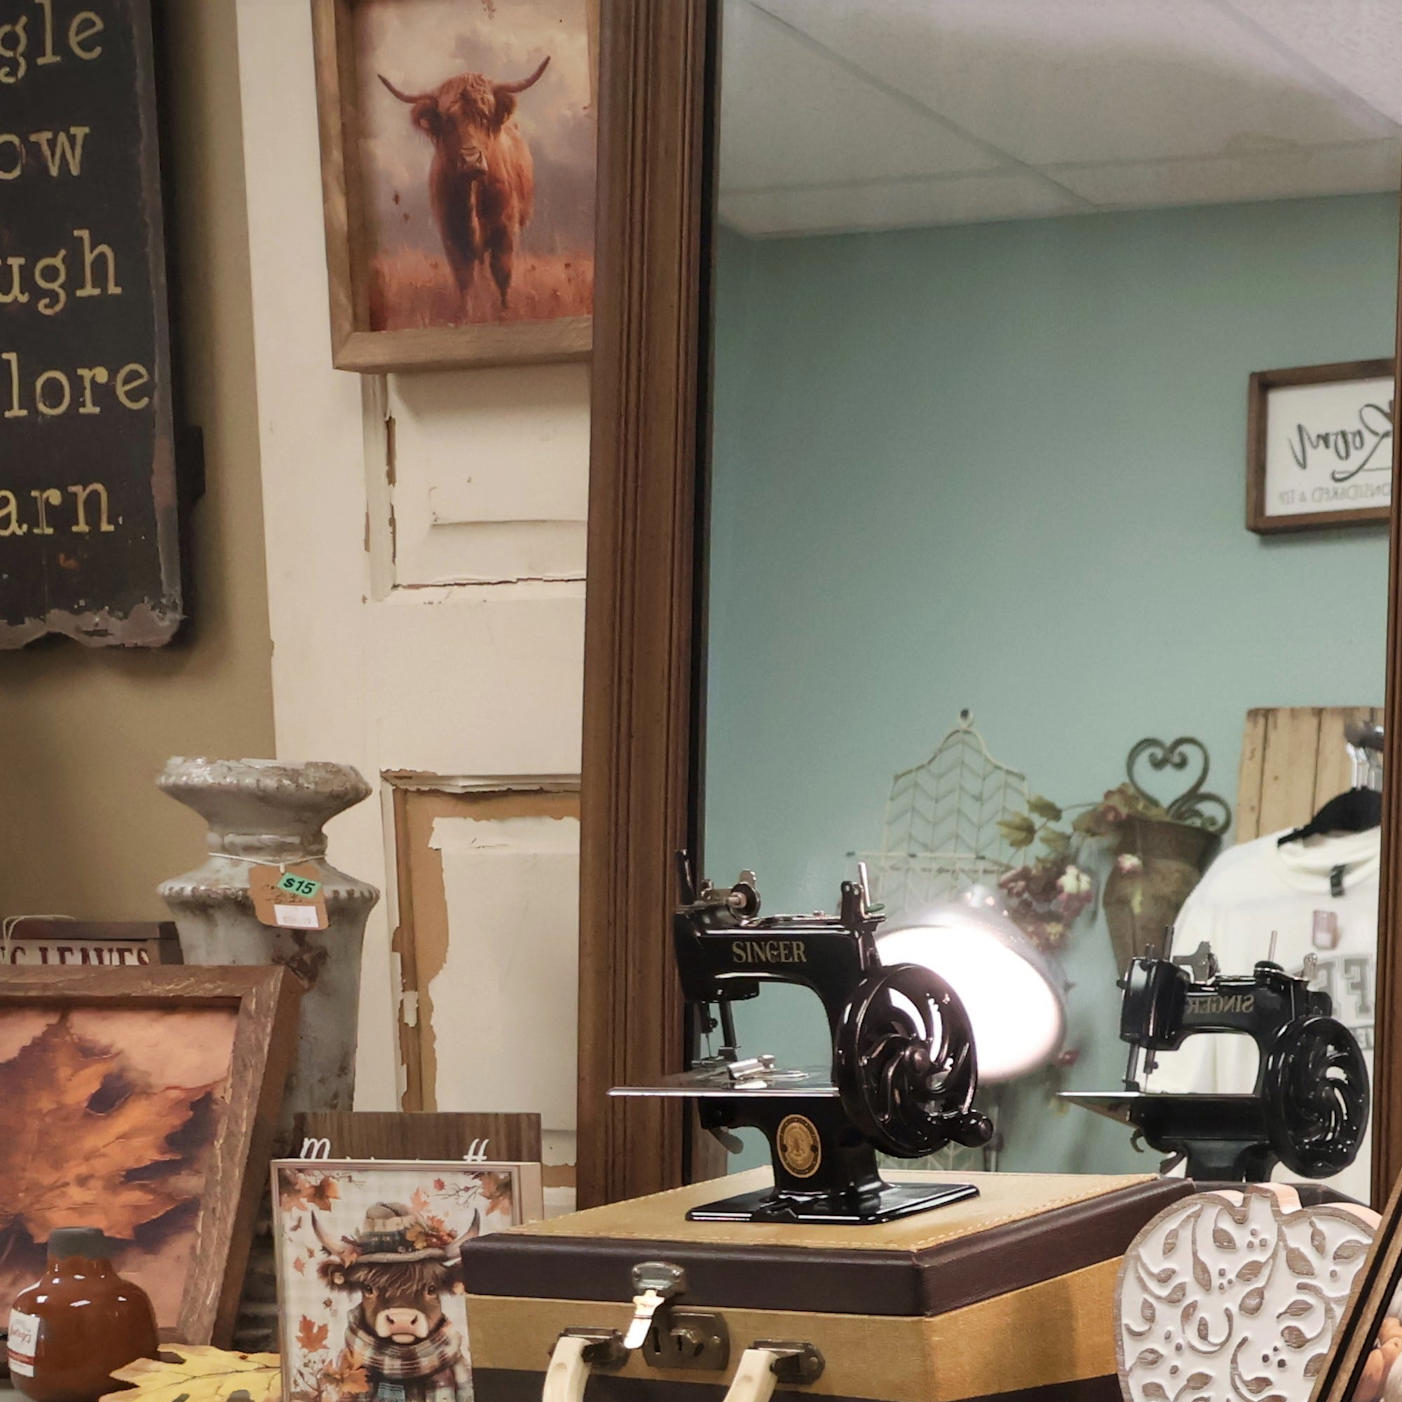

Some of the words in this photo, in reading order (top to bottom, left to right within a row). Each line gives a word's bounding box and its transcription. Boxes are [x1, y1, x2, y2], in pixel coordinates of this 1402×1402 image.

[0, 0, 104, 83] gle
[2, 352, 149, 418] lore
[0, 482, 115, 537] arn
[283, 877, 316, 895] $15
[732, 940, 807, 963] SINGER
